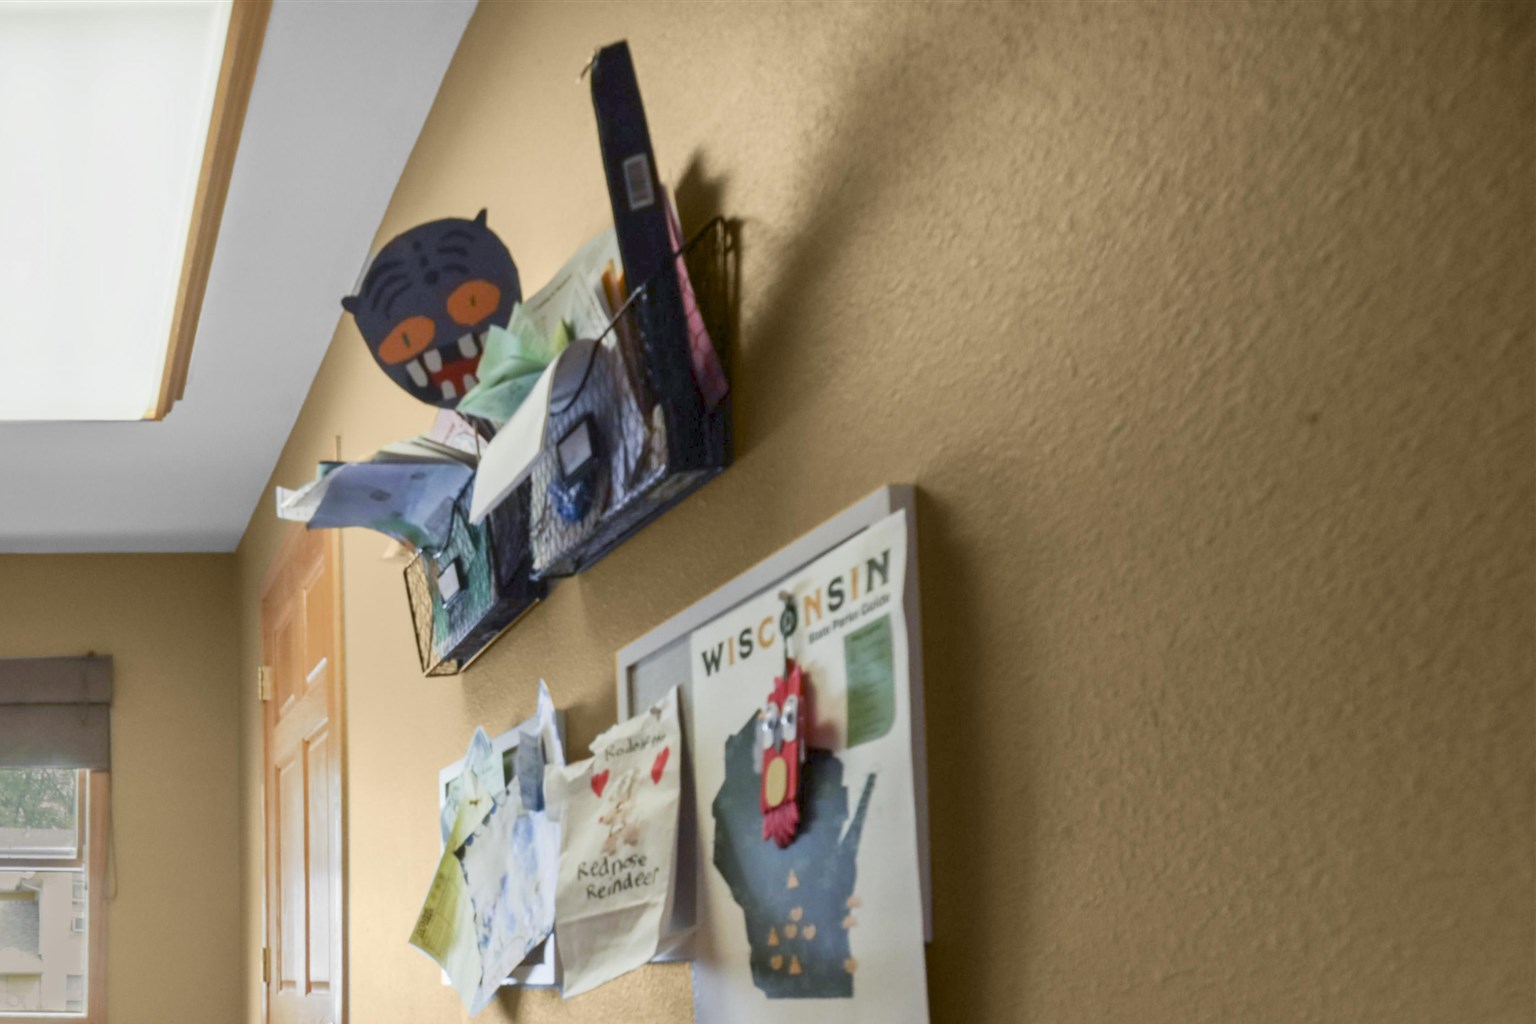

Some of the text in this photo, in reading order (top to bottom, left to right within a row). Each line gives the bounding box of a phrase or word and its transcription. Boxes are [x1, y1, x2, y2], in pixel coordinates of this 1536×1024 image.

[701, 549, 892, 677] WISCONSIN
[809, 626, 830, 644] State
[861, 593, 890, 616] Guide
[585, 867, 660, 900] Reindeer
